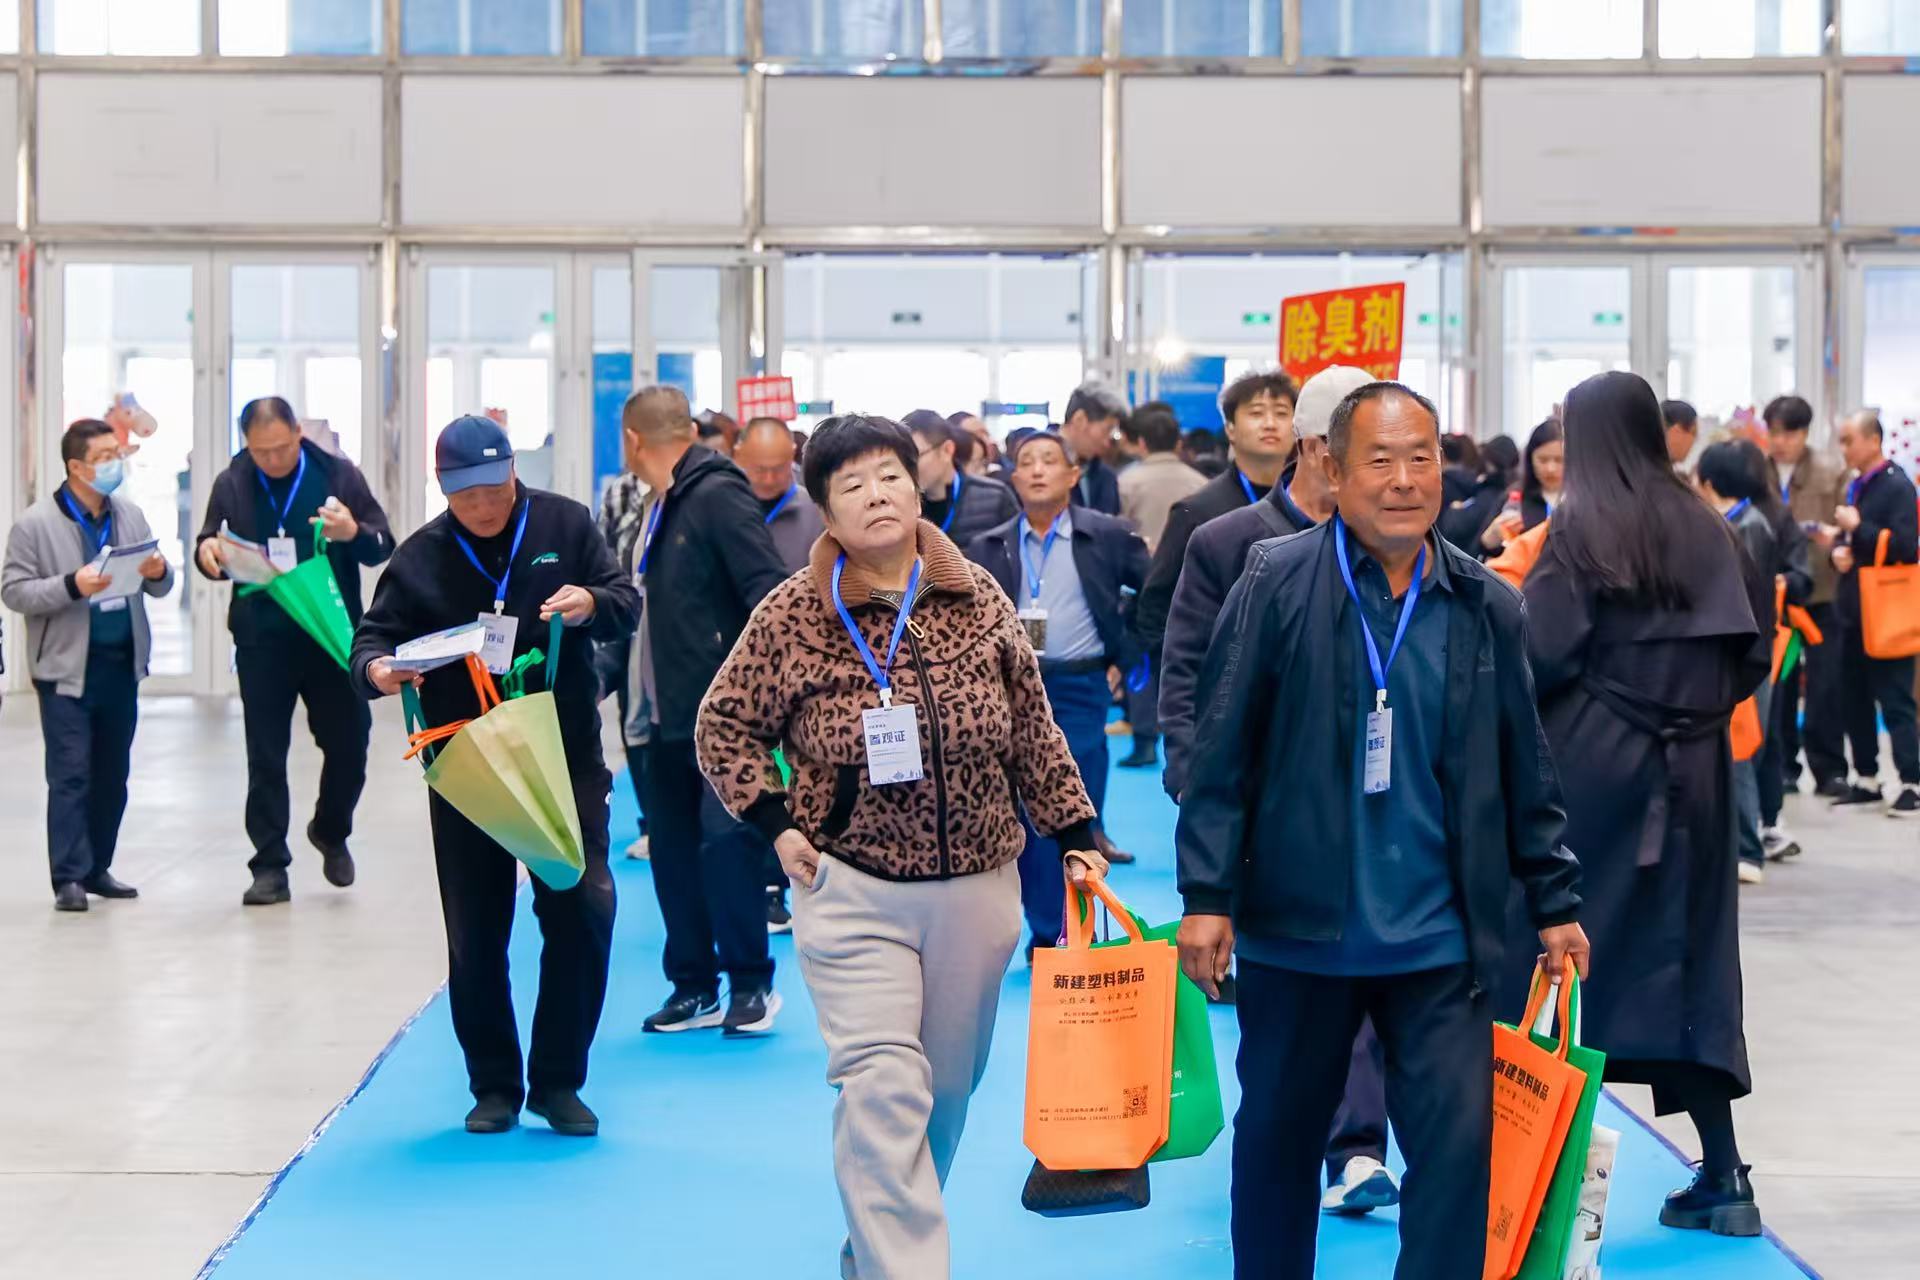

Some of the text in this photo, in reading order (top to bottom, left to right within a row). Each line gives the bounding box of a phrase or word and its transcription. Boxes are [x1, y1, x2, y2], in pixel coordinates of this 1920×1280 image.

[1284, 289, 1400, 364] 除臭剂
[1053, 967, 1145, 990] 新建塑料制品
[1492, 1056, 1549, 1101] 新建塑料制品
